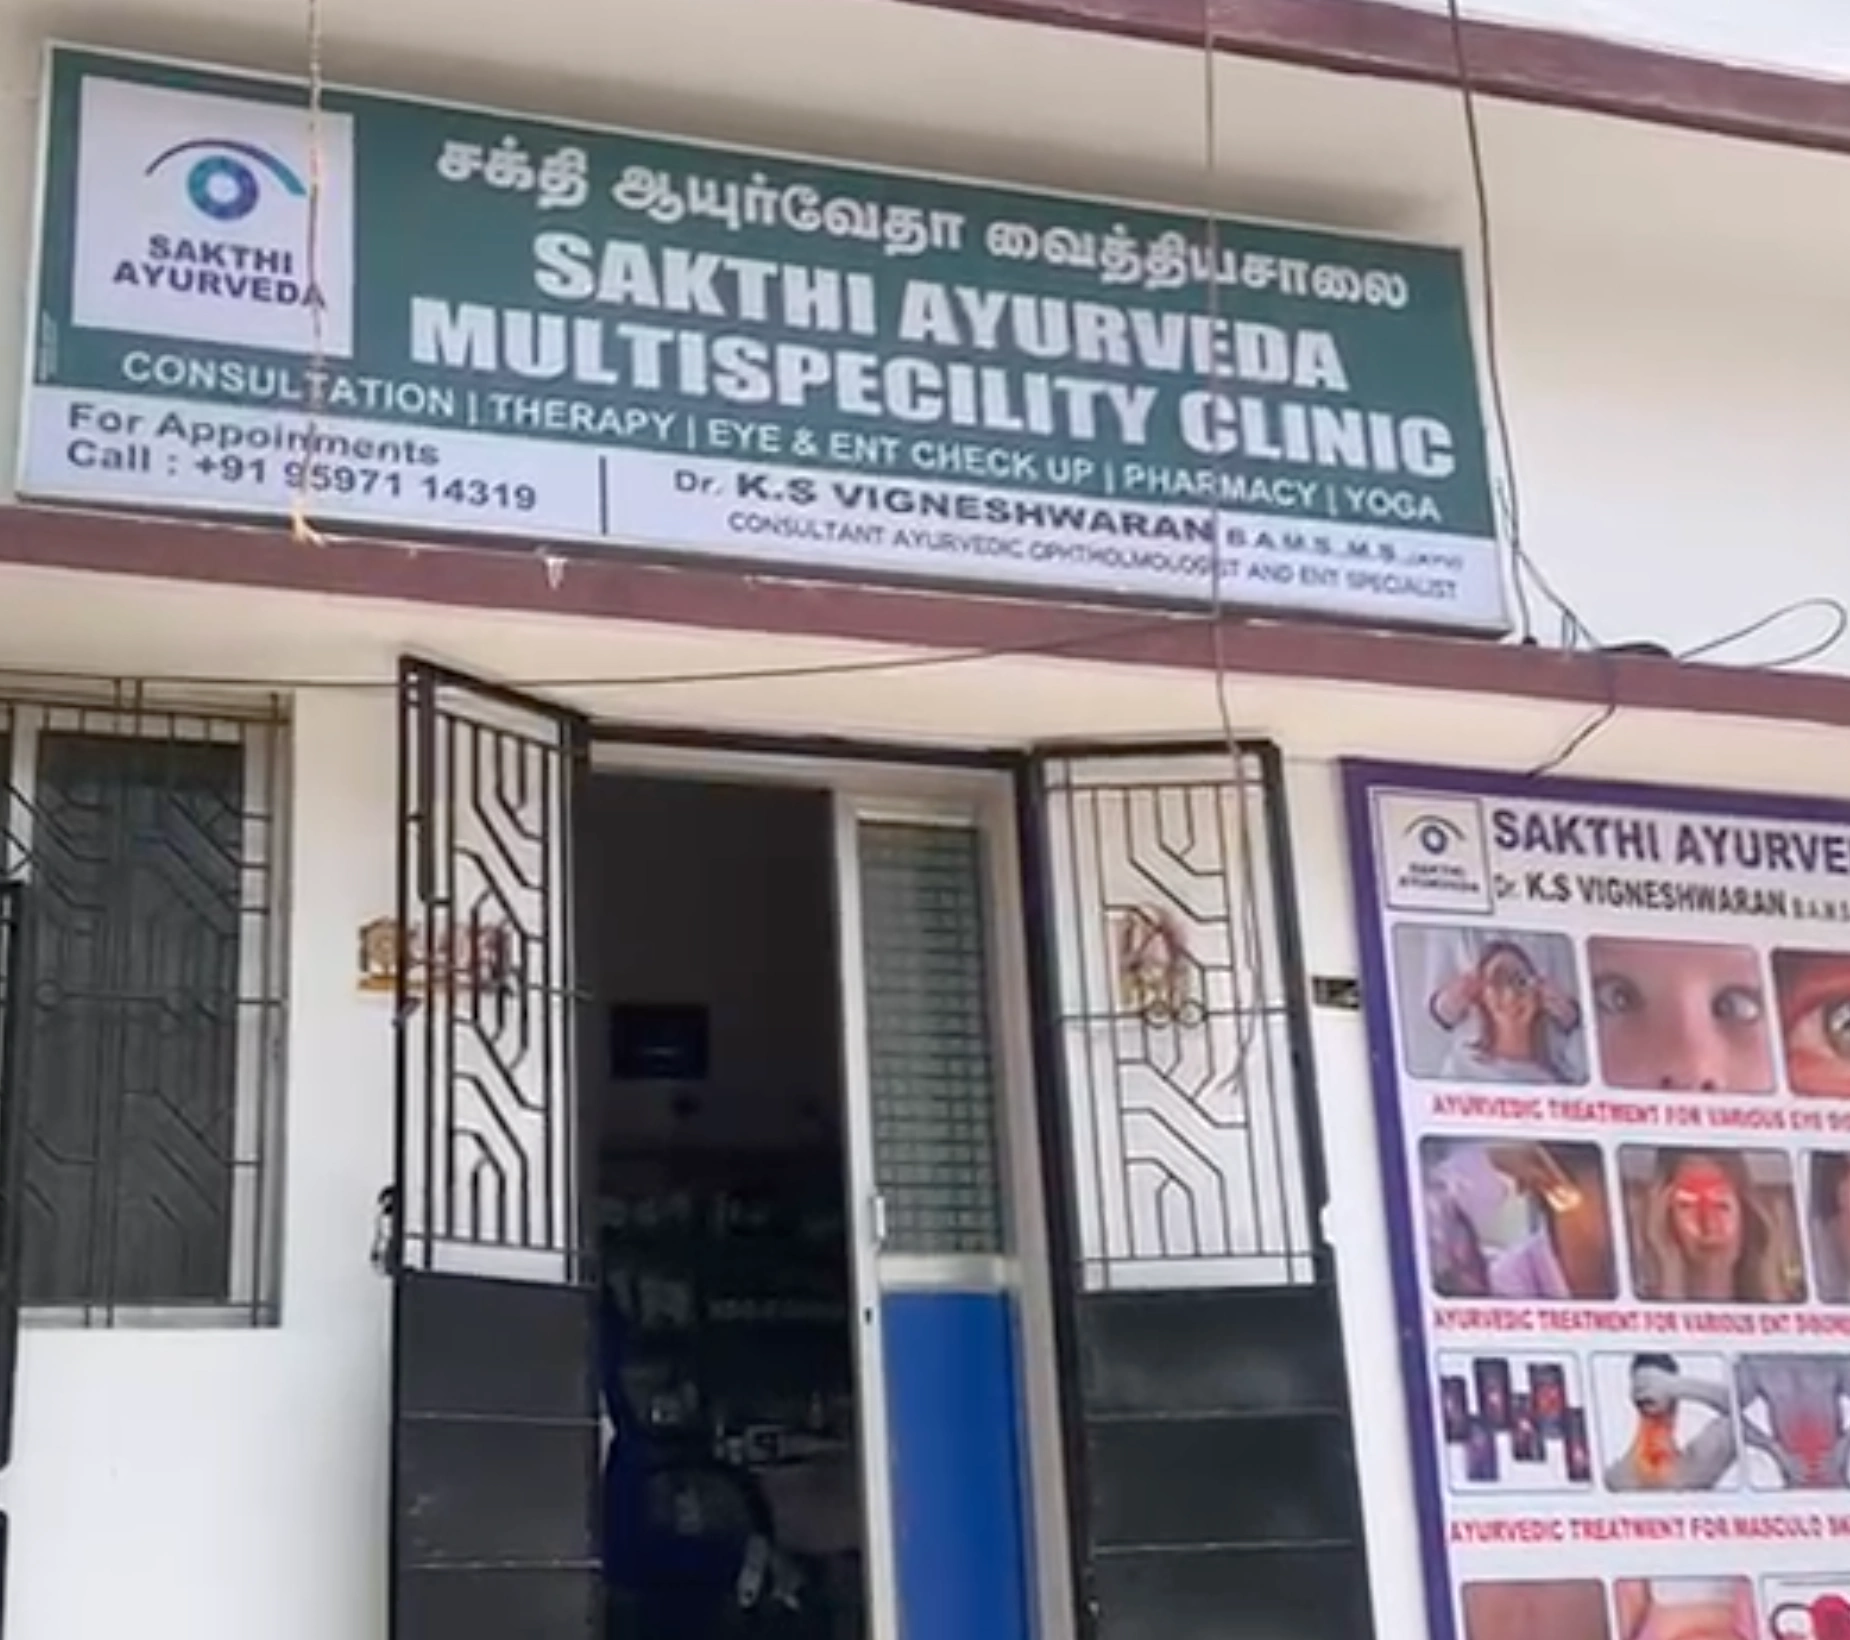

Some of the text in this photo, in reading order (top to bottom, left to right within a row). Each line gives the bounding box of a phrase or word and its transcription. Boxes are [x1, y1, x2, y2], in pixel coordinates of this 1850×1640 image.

[148, 233, 294, 275] SAKTHI
[437, 135, 1407, 309] சக்தி ஆயுர்வேதா வைத்தியசாலை
[112, 260, 326, 309] AYURVEDA
[533, 231, 1349, 391] SAKTHI AYURVEDA
[409, 297, 1457, 478] MULTISPECILITY CLINIC
[67, 403, 441, 467] For Appoinments
[122, 350, 1442, 522] CONSULTATION THERAPY EYE & ENT CHECK UP PHARMACY YOGA
[67, 440, 152, 472] Call
[195, 455, 266, 485] +91
[284, 462, 402, 496] 95971
[420, 474, 537, 511] 14319
[736, 473, 817, 503] K.S
[832, 483, 1214, 543] VIGNESHWARAN
[727, 511, 886, 544] CONSULTANT
[893, 529, 1024, 560] AYURVEDIC
[1028, 541, 1239, 577] OPHTHOLMOLOGST
[1248, 562, 1293, 584] AND
[1300, 566, 1338, 587] ENT
[1492, 808, 1850, 875] SAKTHI AYURVE
[1577, 875, 1788, 917] VIGNESHWARAN
[1452, 1518, 1564, 1542] AYURVEDIC
[1690, 1516, 1730, 1540] FOR
